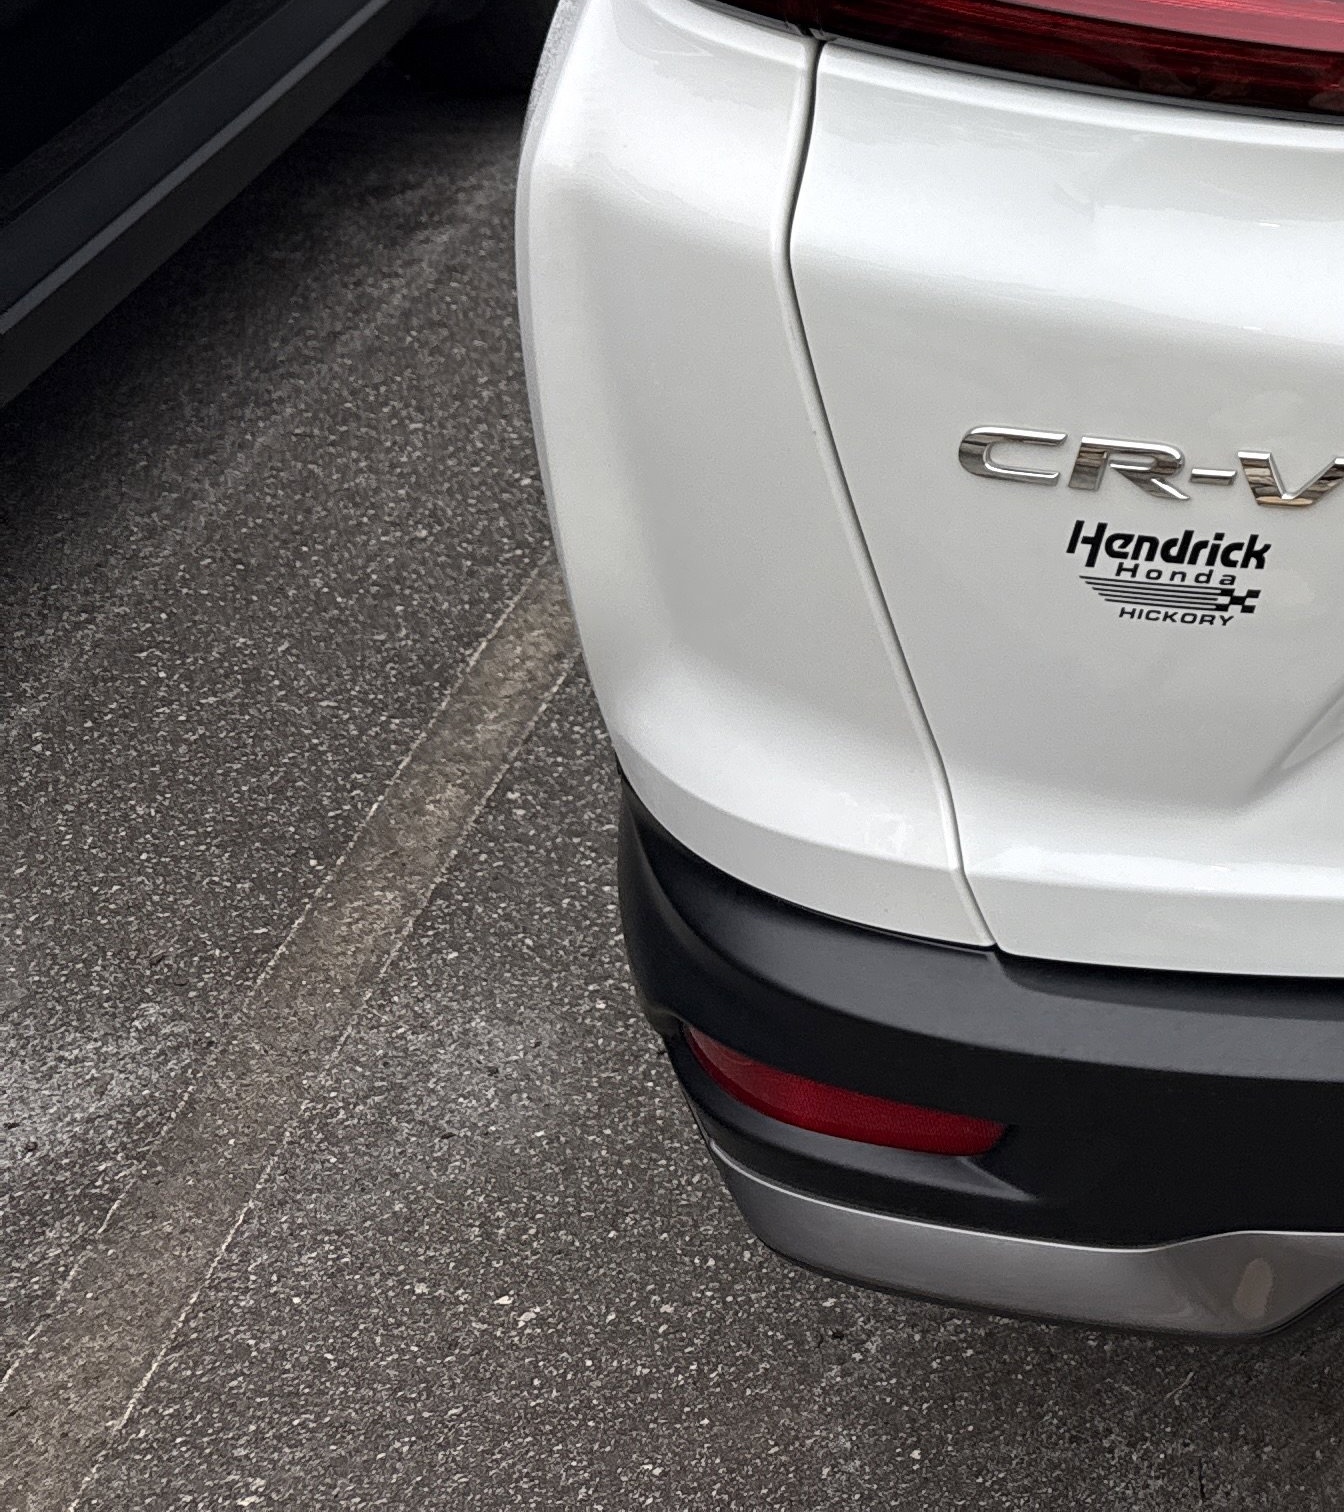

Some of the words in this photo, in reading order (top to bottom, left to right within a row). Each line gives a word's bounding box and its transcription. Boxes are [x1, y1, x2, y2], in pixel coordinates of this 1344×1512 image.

[1066, 519, 1271, 569] Hendrick
[1115, 561, 1236, 586] Honda
[1118, 606, 1234, 627] HICKORY
